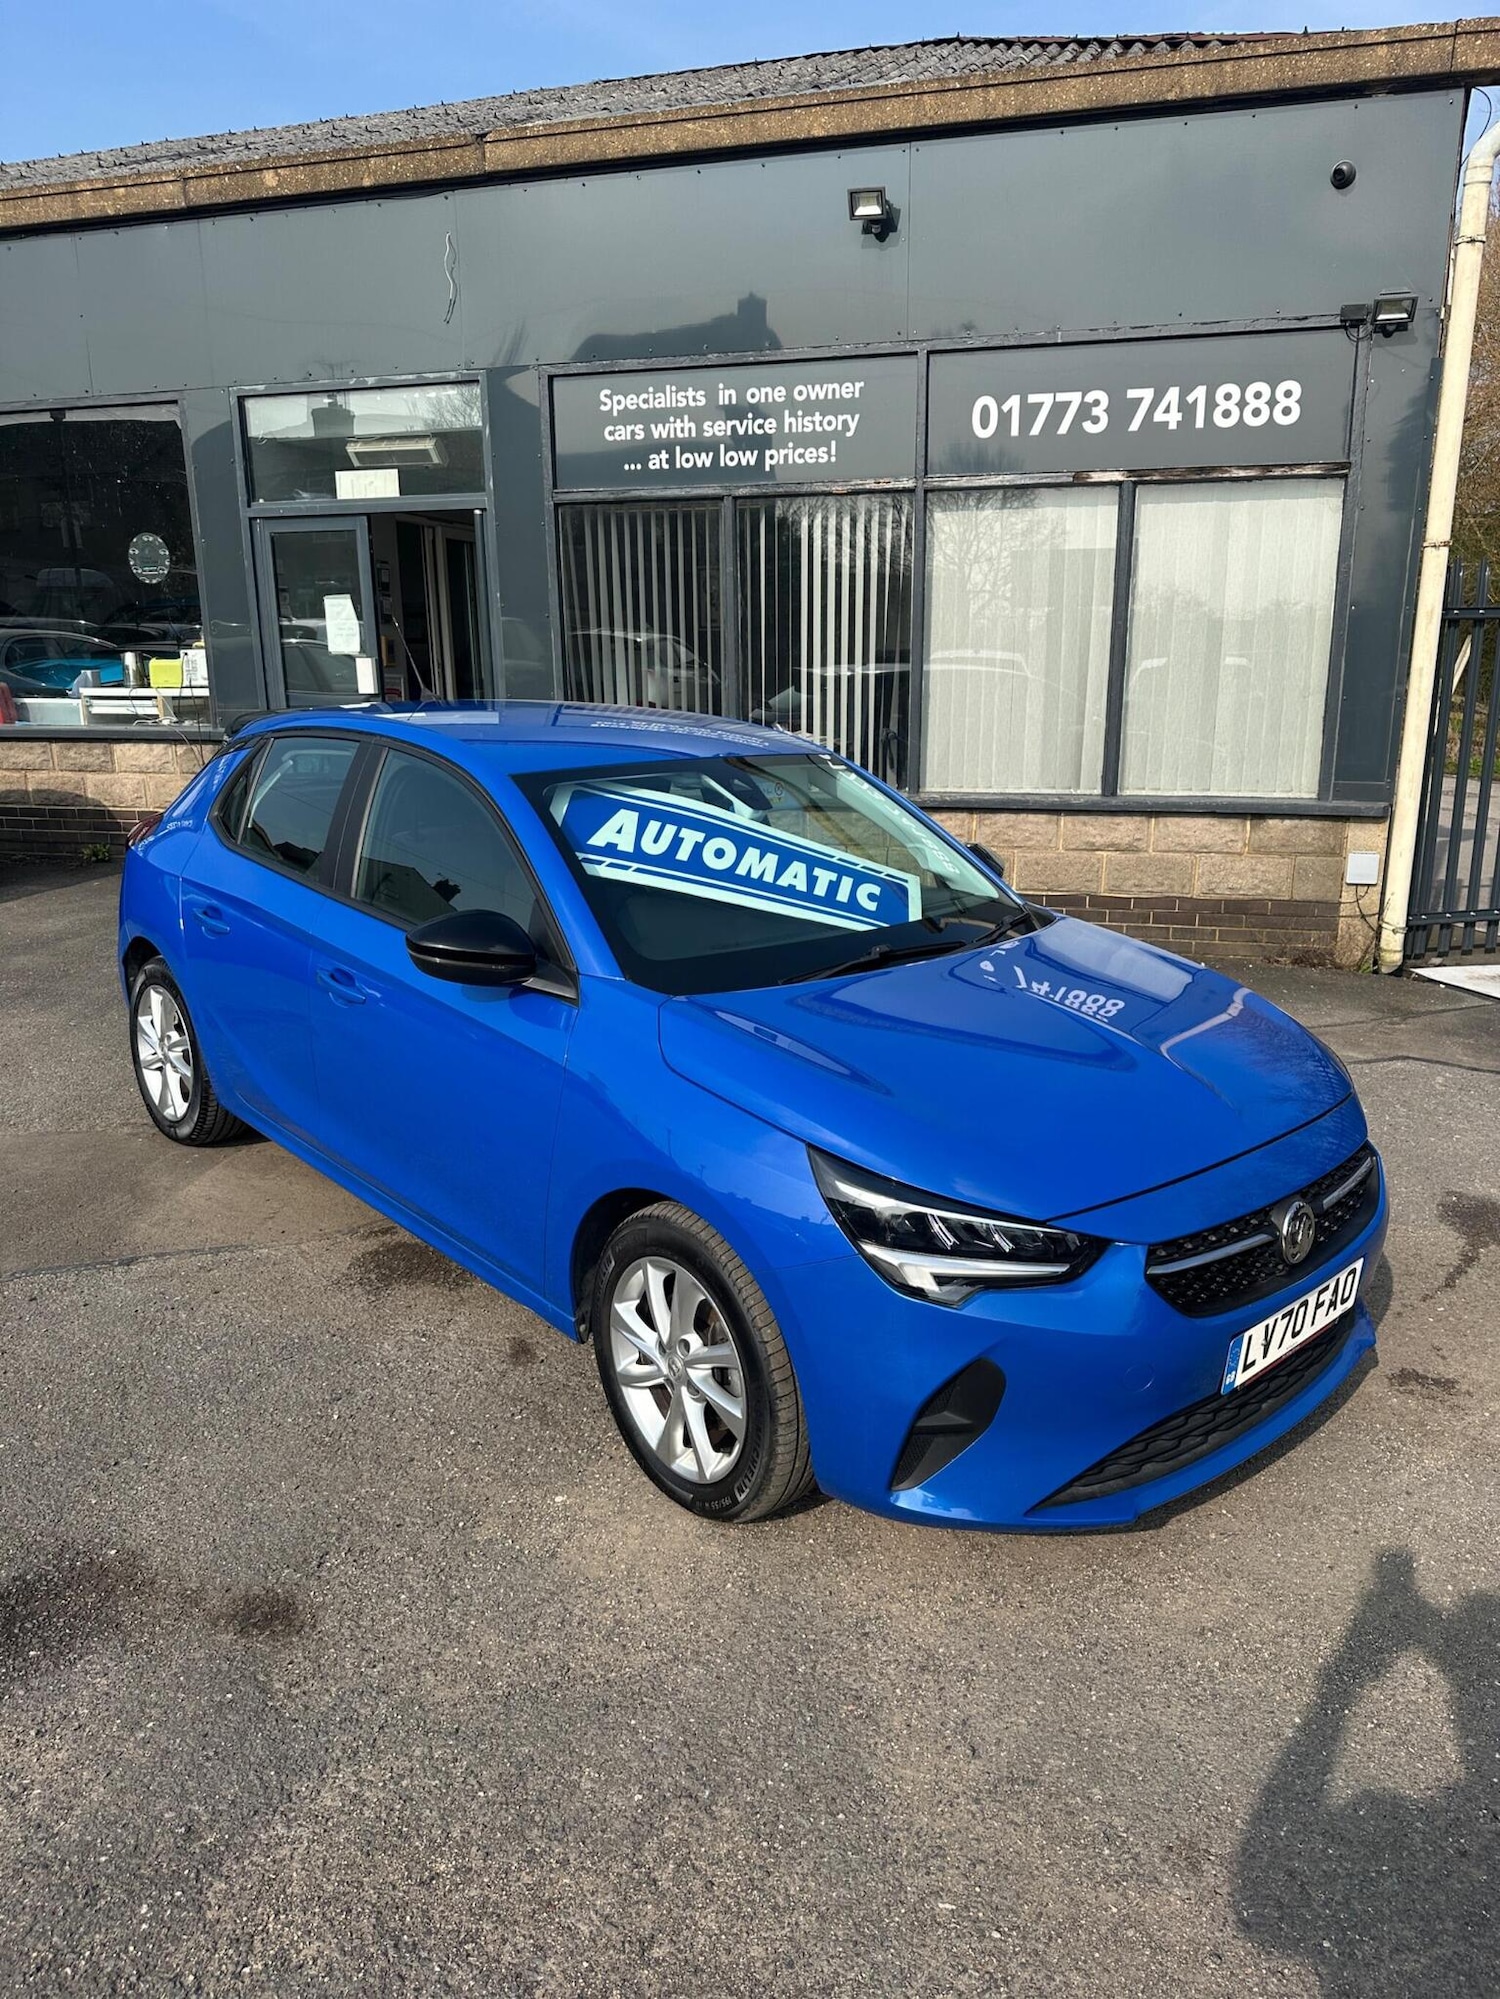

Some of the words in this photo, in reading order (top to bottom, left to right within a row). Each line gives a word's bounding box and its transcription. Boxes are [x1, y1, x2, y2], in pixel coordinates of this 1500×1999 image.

[599, 384, 706, 416] Specialists
[718, 383, 737, 405] in
[746, 385, 787, 404] one
[793, 379, 865, 402] owner
[971, 389, 1109, 439] 01773
[1126, 379, 1302, 432] 741888
[603, 423, 645, 442] cars
[650, 415, 697, 439] with
[702, 412, 777, 438] service
[784, 409, 860, 437] history
[648, 451, 670, 470] at
[675, 446, 713, 469] low
[719, 444, 758, 467] low
[765, 440, 837, 472] prices!
[586, 808, 882, 912] AUTOMATIC
[1241, 1298, 1309, 1374] LV70
[1310, 1266, 1357, 1327] FAO
